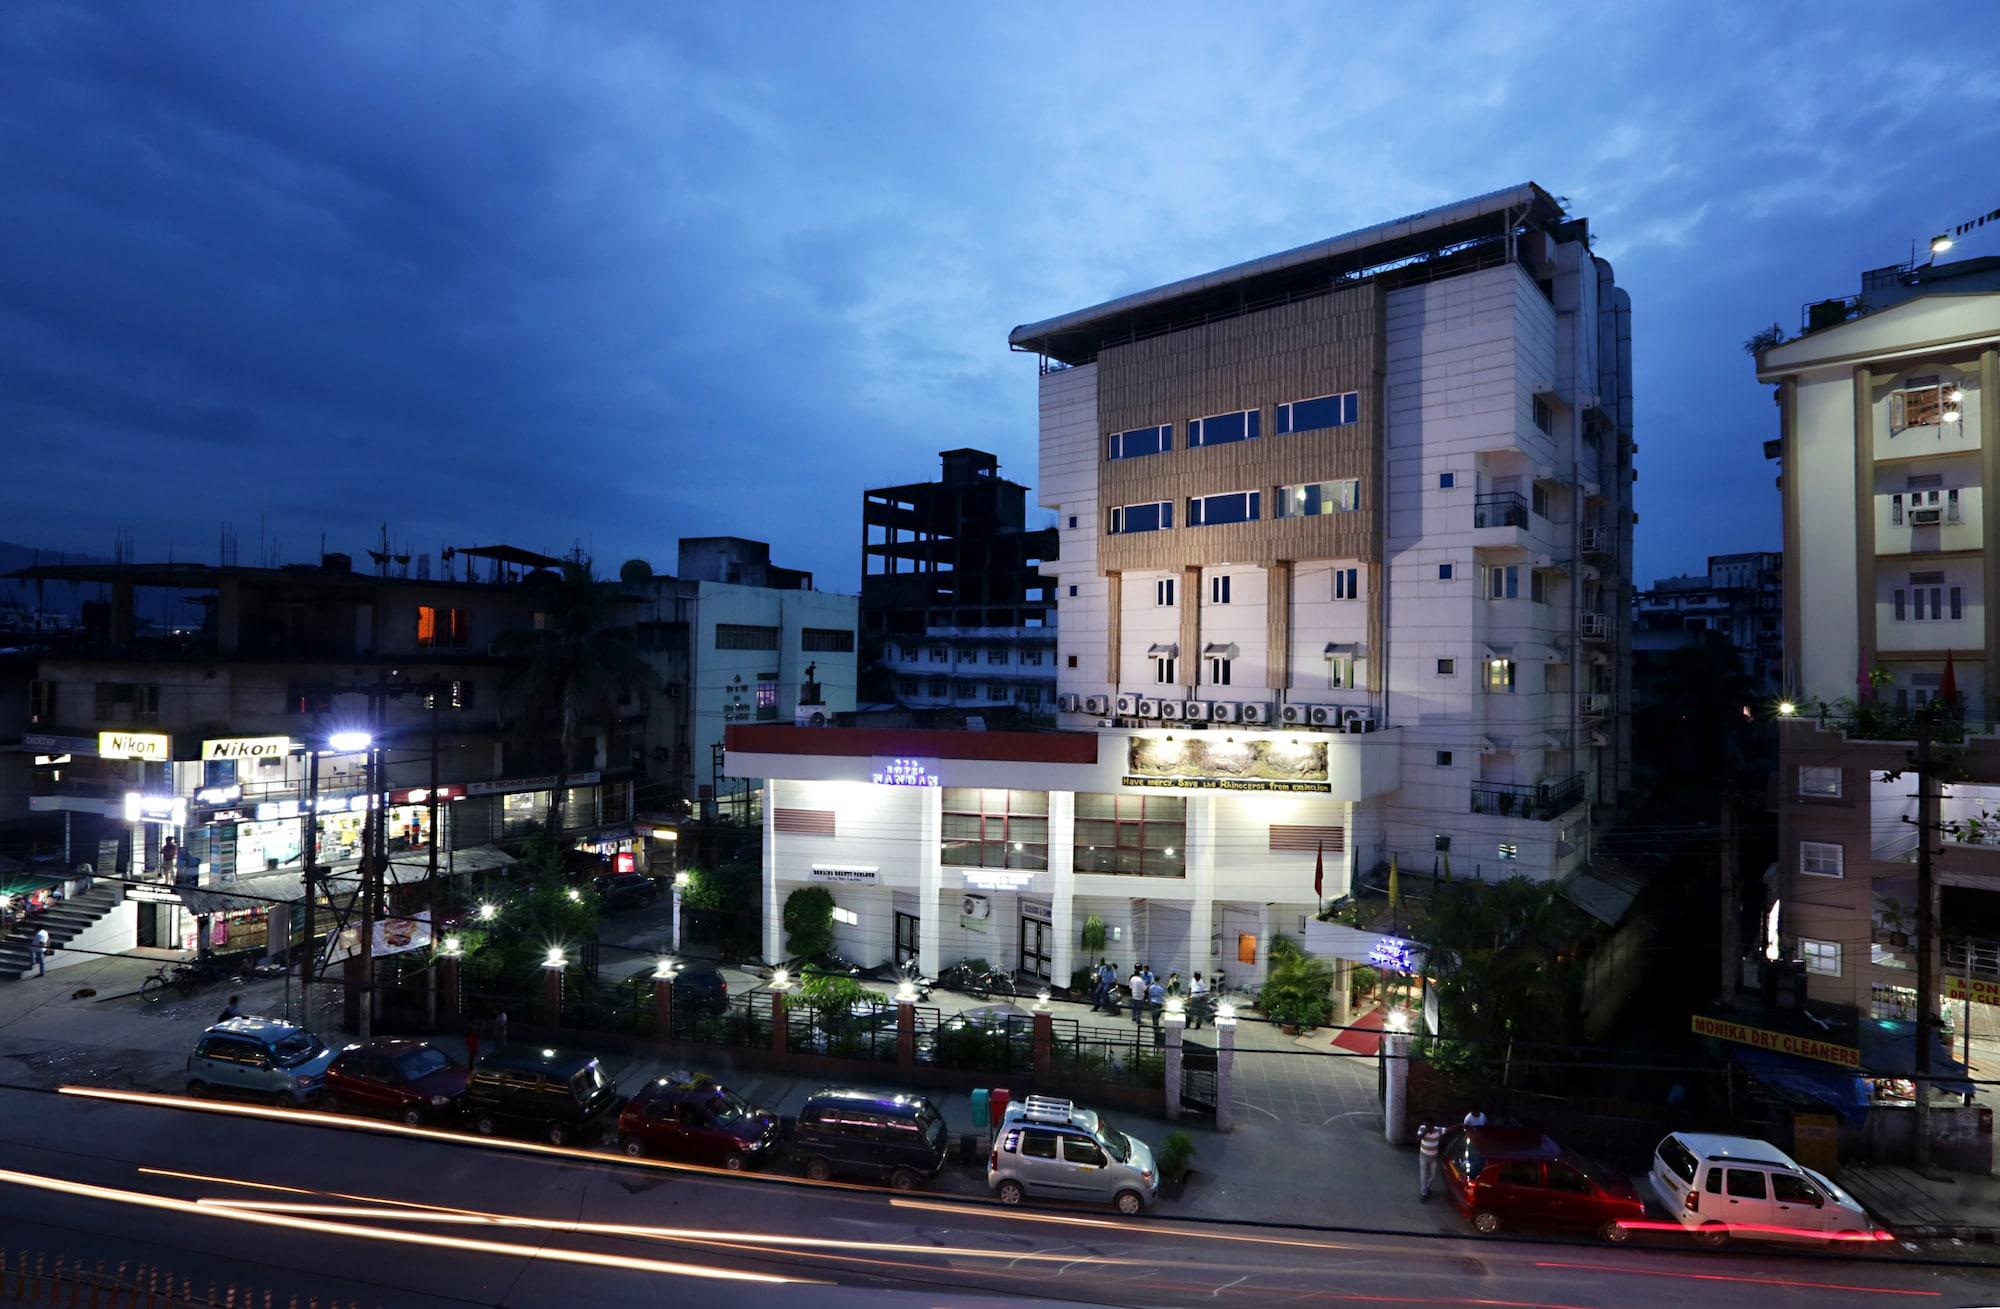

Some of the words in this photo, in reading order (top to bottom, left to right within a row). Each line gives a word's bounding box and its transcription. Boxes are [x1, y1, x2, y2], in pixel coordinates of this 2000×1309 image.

[112, 737, 156, 754] Nikon
[213, 743, 278, 757] Nikon
[1123, 776, 1144, 786] Have
[1178, 778, 1199, 788] Save
[1220, 780, 1265, 790] Rhinoceros
[1269, 782, 1290, 791] from
[1694, 1018, 1746, 1042] MONIKA
[1751, 1029, 1778, 1047] DRY
[1783, 1036, 1858, 1066] CLEANERS
